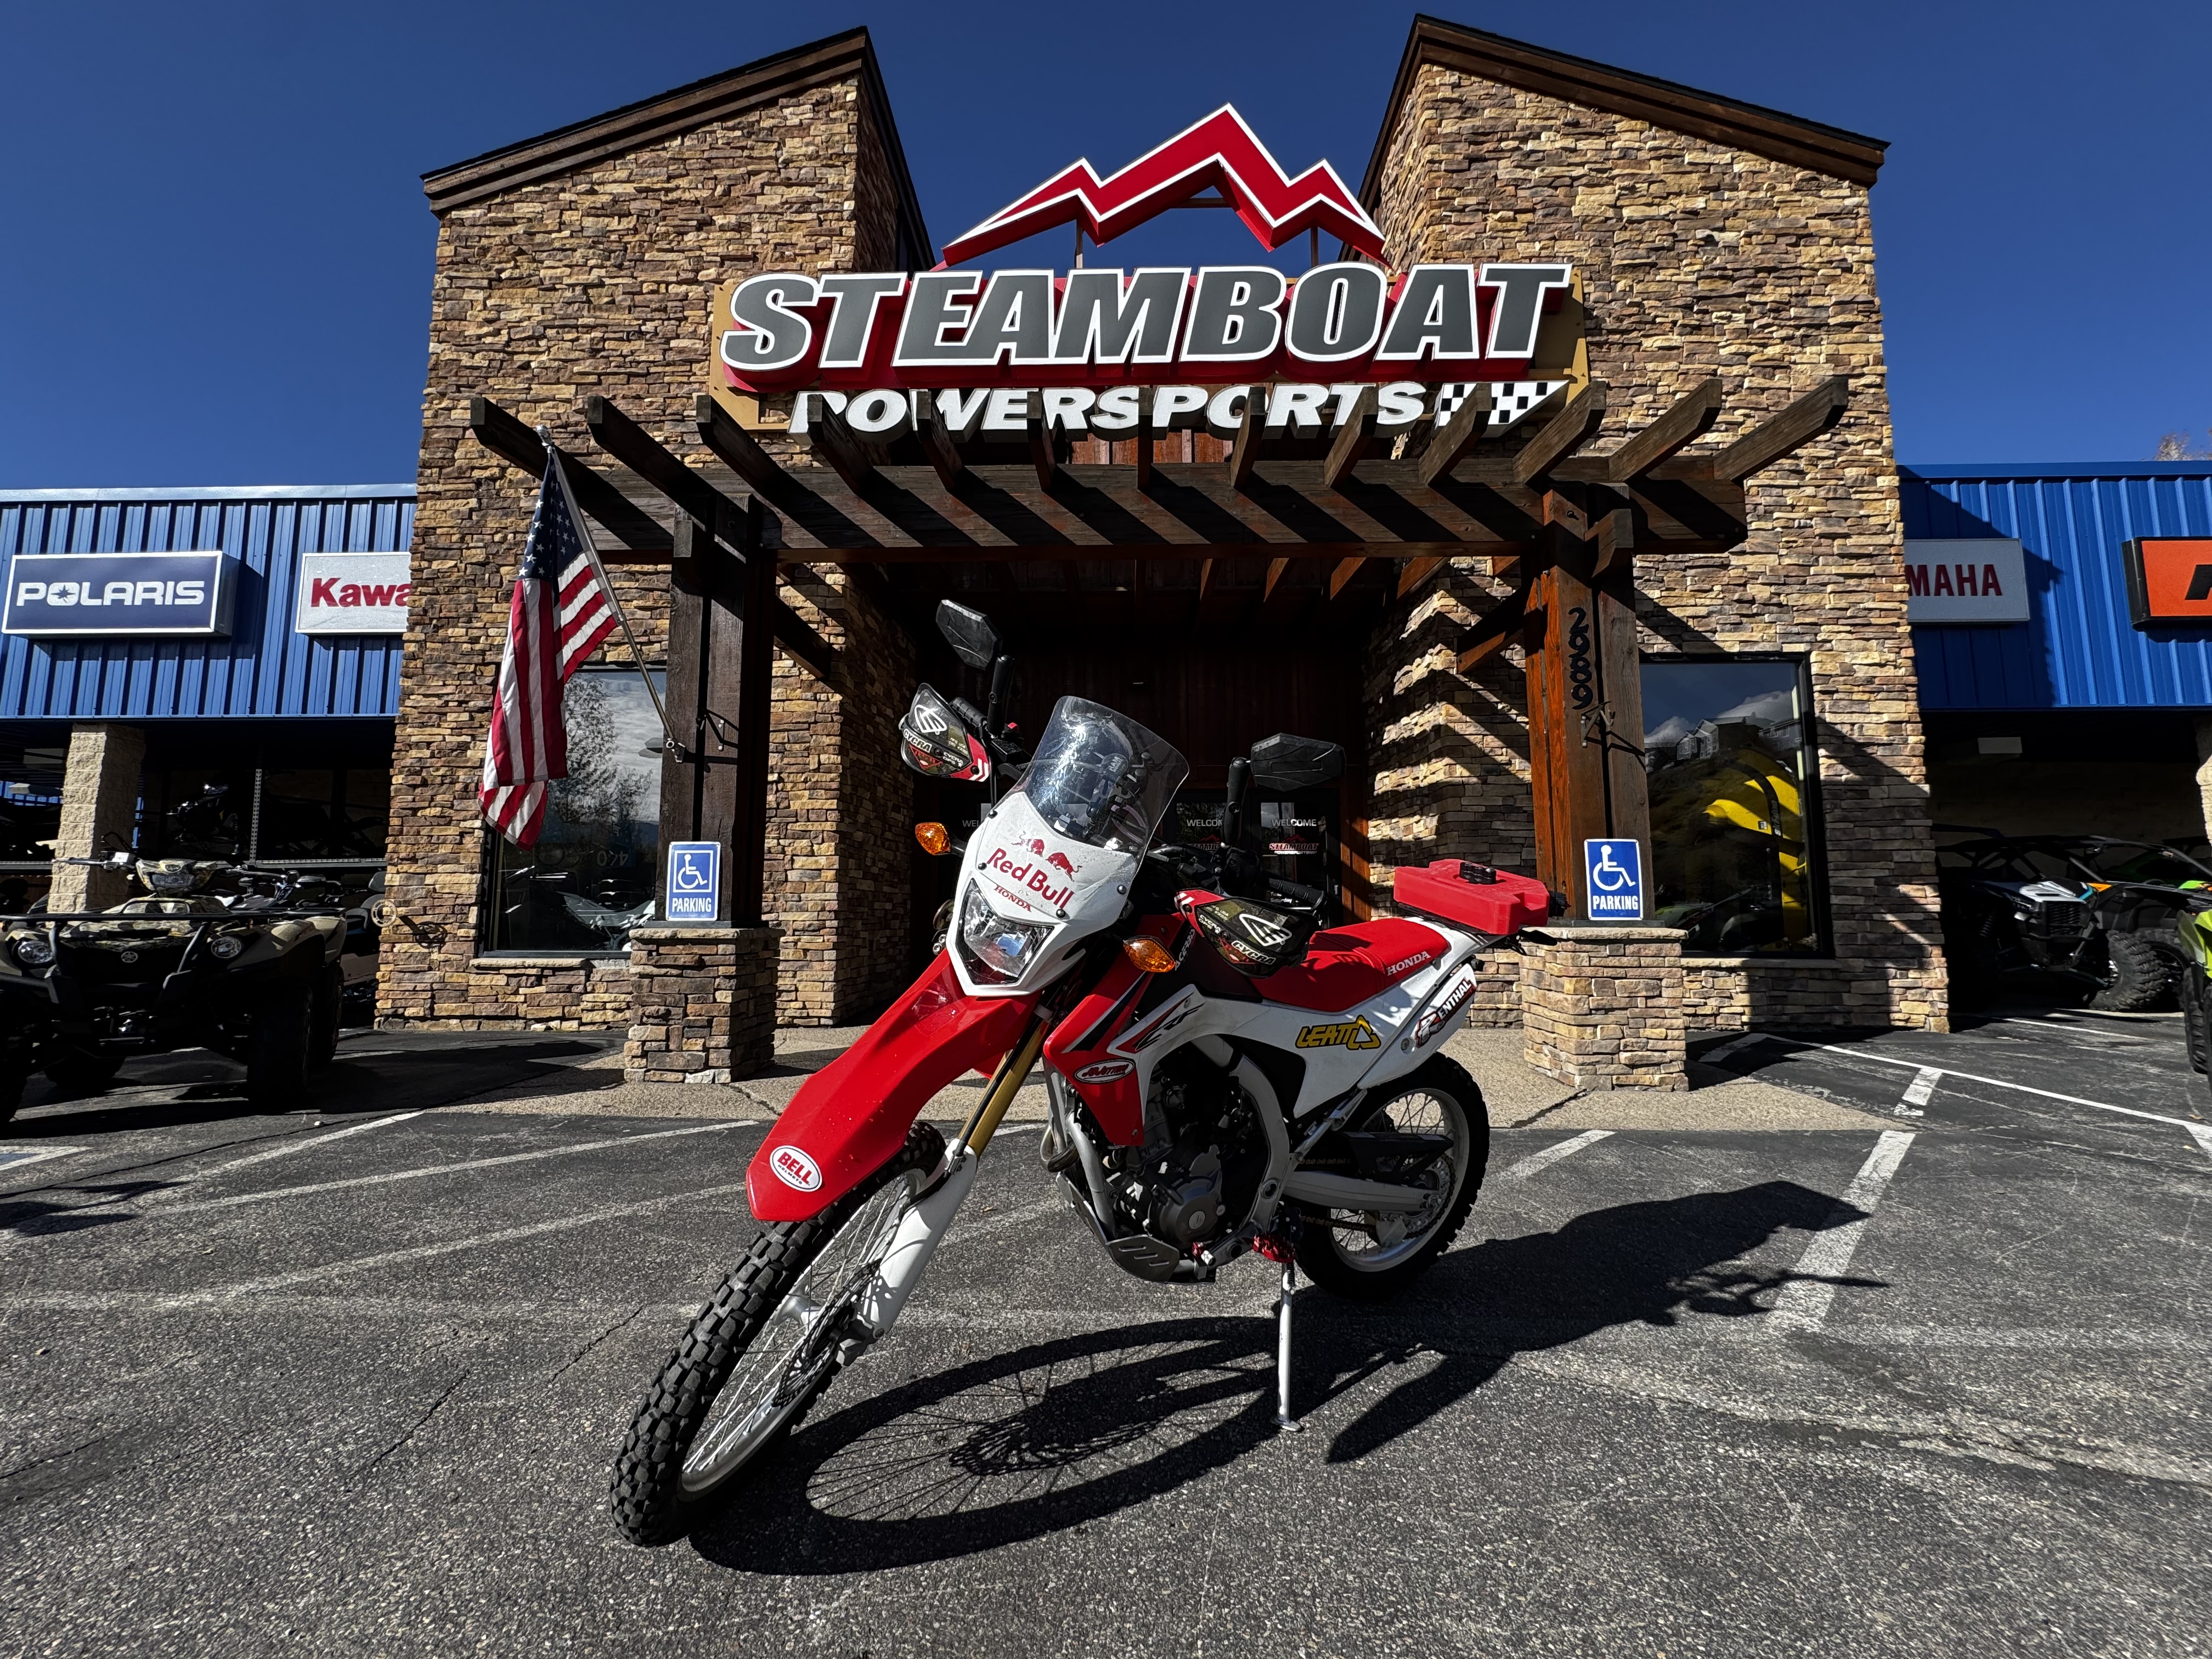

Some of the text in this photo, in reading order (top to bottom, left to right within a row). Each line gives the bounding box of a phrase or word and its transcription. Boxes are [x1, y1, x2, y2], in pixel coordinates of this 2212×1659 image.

[719, 261, 1572, 371] STEAMBOAT
[787, 381, 1427, 433] POWERSPORTS
[16, 580, 205, 607] POLARIS
[310, 578, 411, 608] Kawa
[1567, 607, 1594, 710] 2989
[903, 729, 932, 753] CYCRA
[943, 752, 963, 765] CYCRA
[1271, 819, 1317, 827] WELCOME
[987, 848, 1074, 910] Red Bull
[672, 896, 712, 913] PARKING
[994, 885, 1032, 912] HONDA
[1593, 894, 1639, 911] PARKING
[1199, 915, 1221, 930] CYCRA
[1231, 940, 1277, 965] CYCRA
[1386, 951, 1431, 977] HONDA
[777, 1151, 812, 1185] BELL
